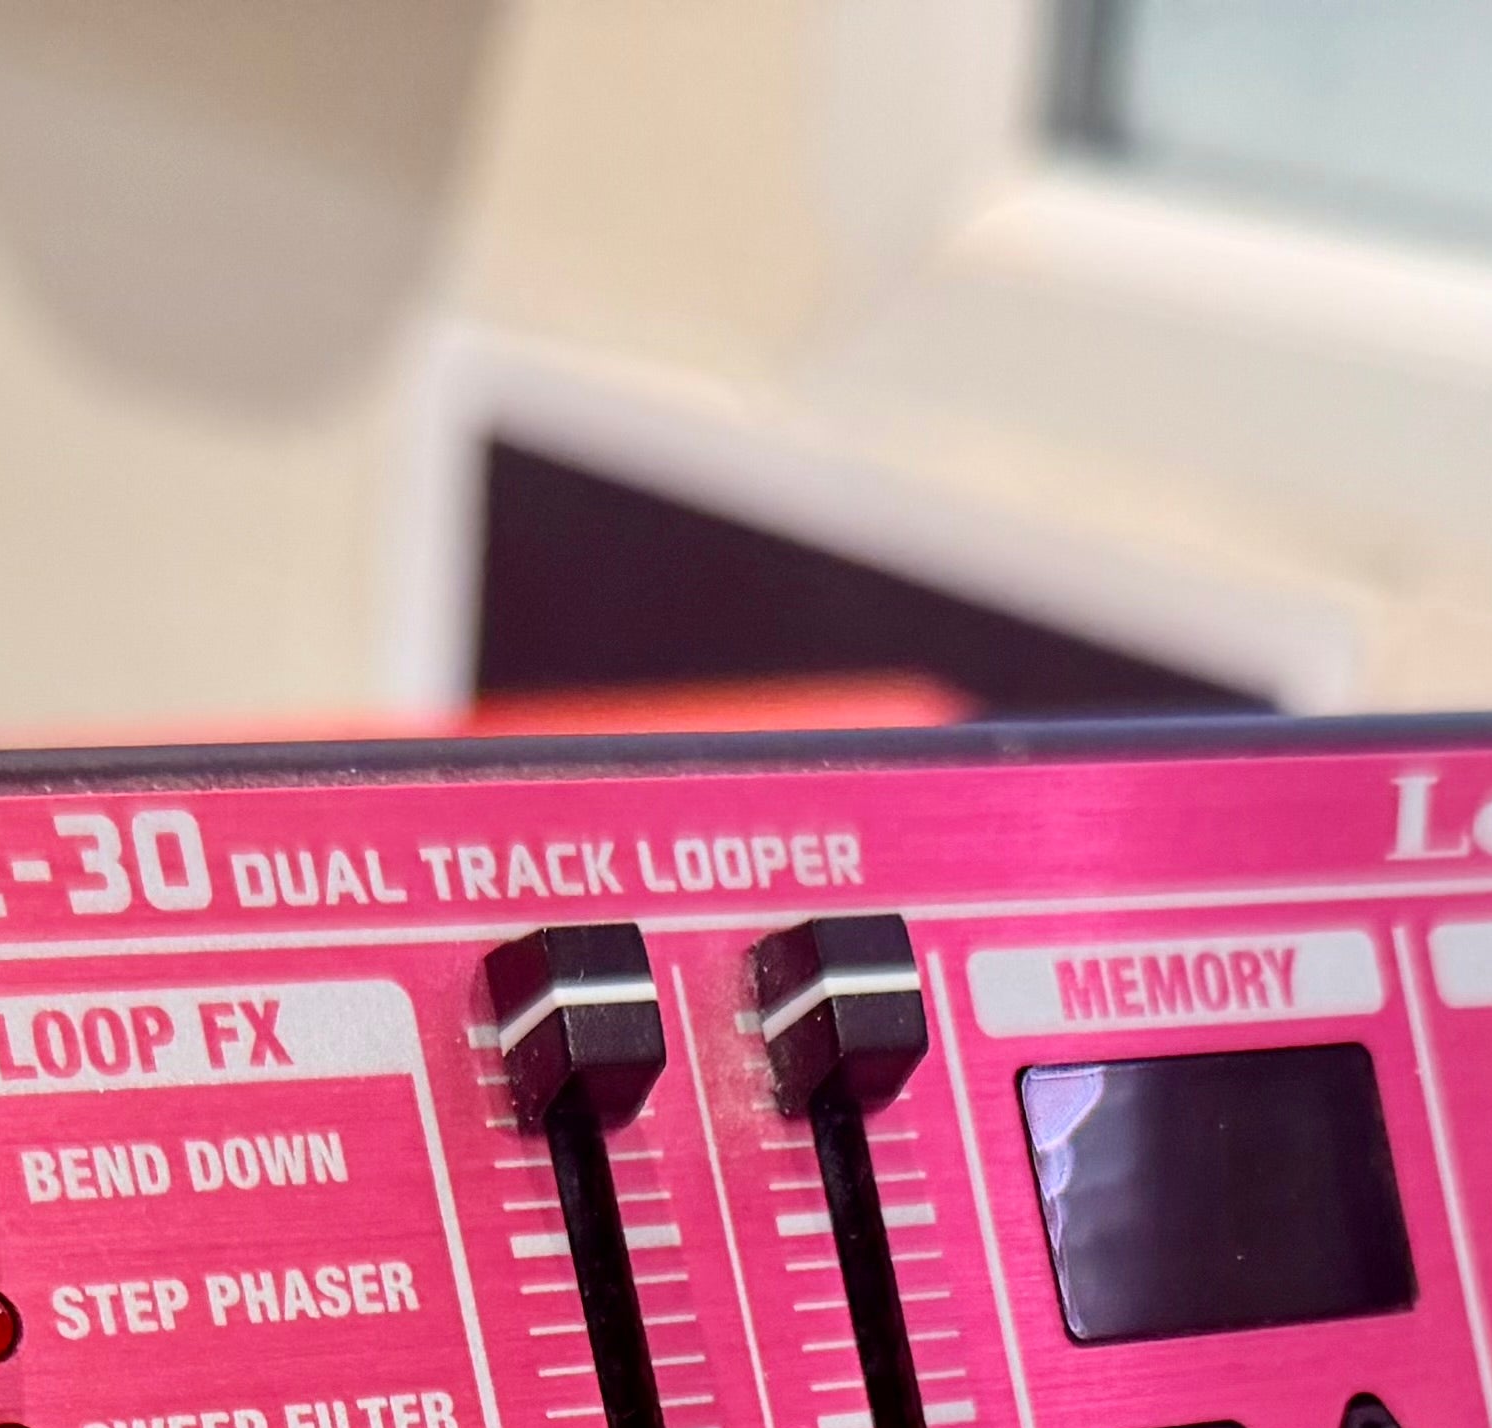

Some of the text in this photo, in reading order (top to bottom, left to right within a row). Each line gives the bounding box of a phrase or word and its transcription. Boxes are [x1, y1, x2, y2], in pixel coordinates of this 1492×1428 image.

[231, 850, 407, 908] DUAL
[420, 839, 623, 901] TRACK
[637, 833, 863, 894] LOOPER
[1054, 947, 1297, 1022] MEMORY
[200, 1000, 296, 1069] FX
[21, 1131, 349, 1202] BEND DOWN
[51, 1261, 420, 1341] STEP PHASER
